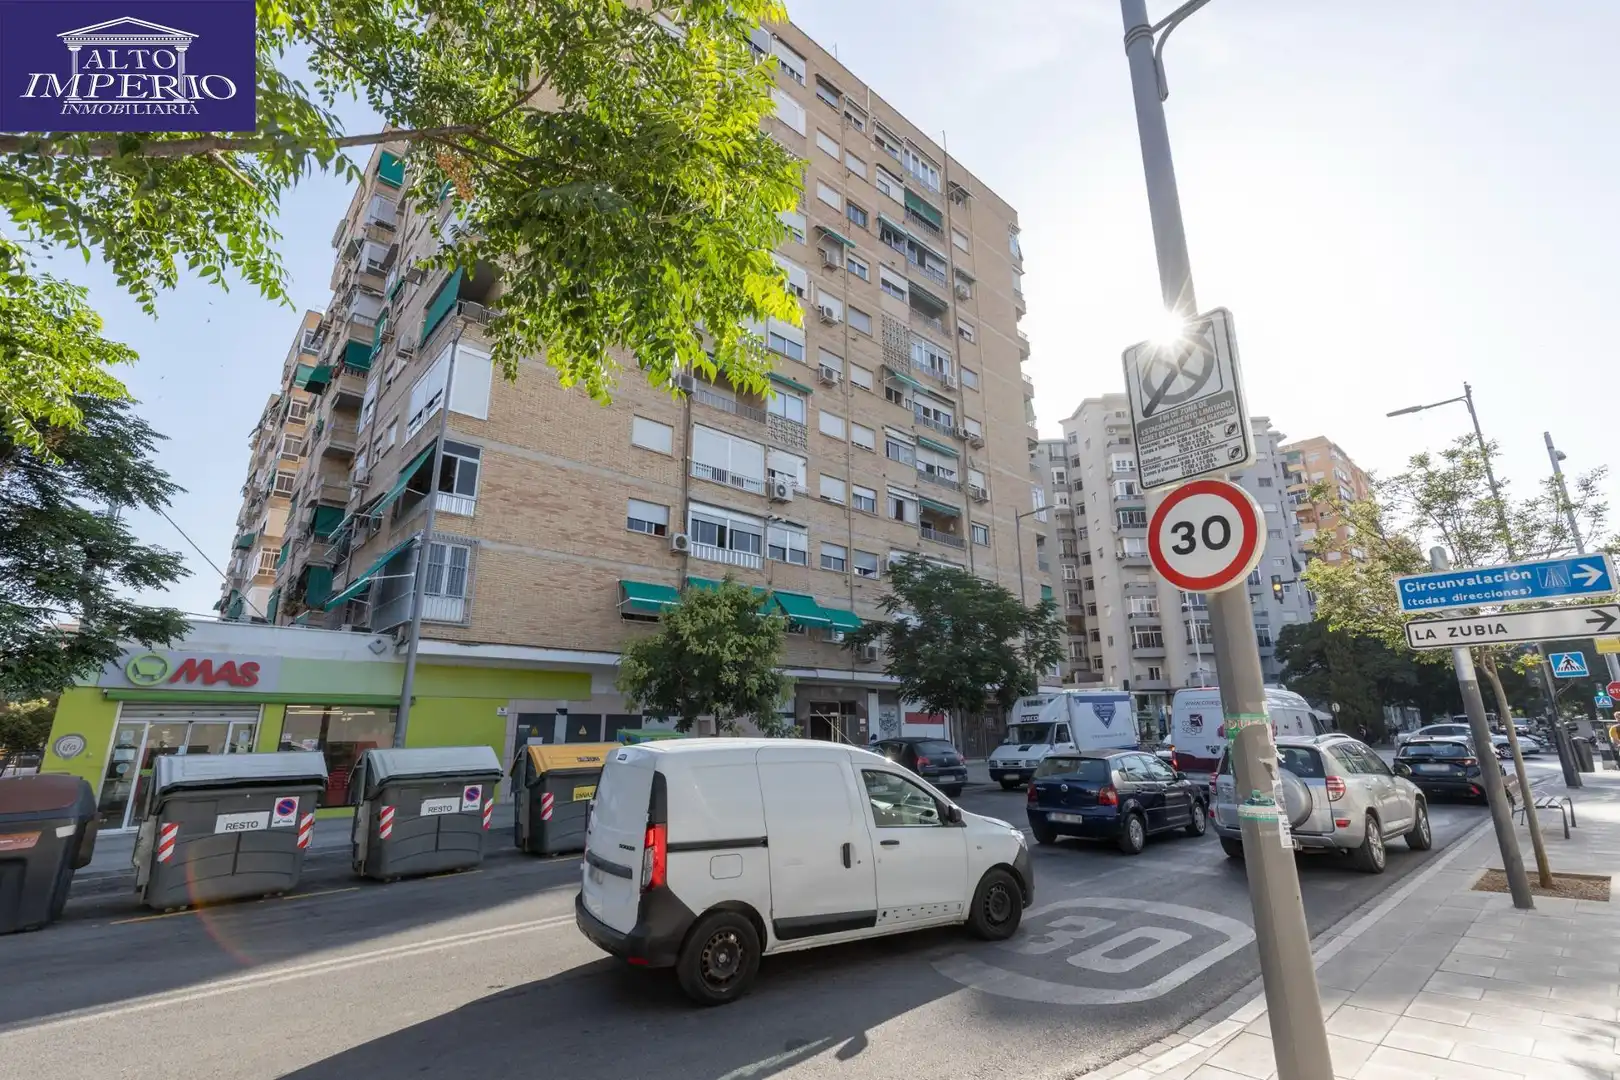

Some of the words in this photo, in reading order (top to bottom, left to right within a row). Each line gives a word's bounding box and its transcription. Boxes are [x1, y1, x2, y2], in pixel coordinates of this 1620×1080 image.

[1171, 515, 1231, 555] 30
[1404, 570, 1532, 592] Circunvalación
[1407, 595, 1446, 606] (todas
[1452, 586, 1532, 602] direcciones)
[1415, 628, 1437, 640] LA
[1447, 623, 1508, 638] ZUBIA
[168, 658, 261, 687] MAS
[428, 804, 453, 814] RESTO
[225, 820, 259, 831] RESTO
[1010, 915, 1193, 974] 30
